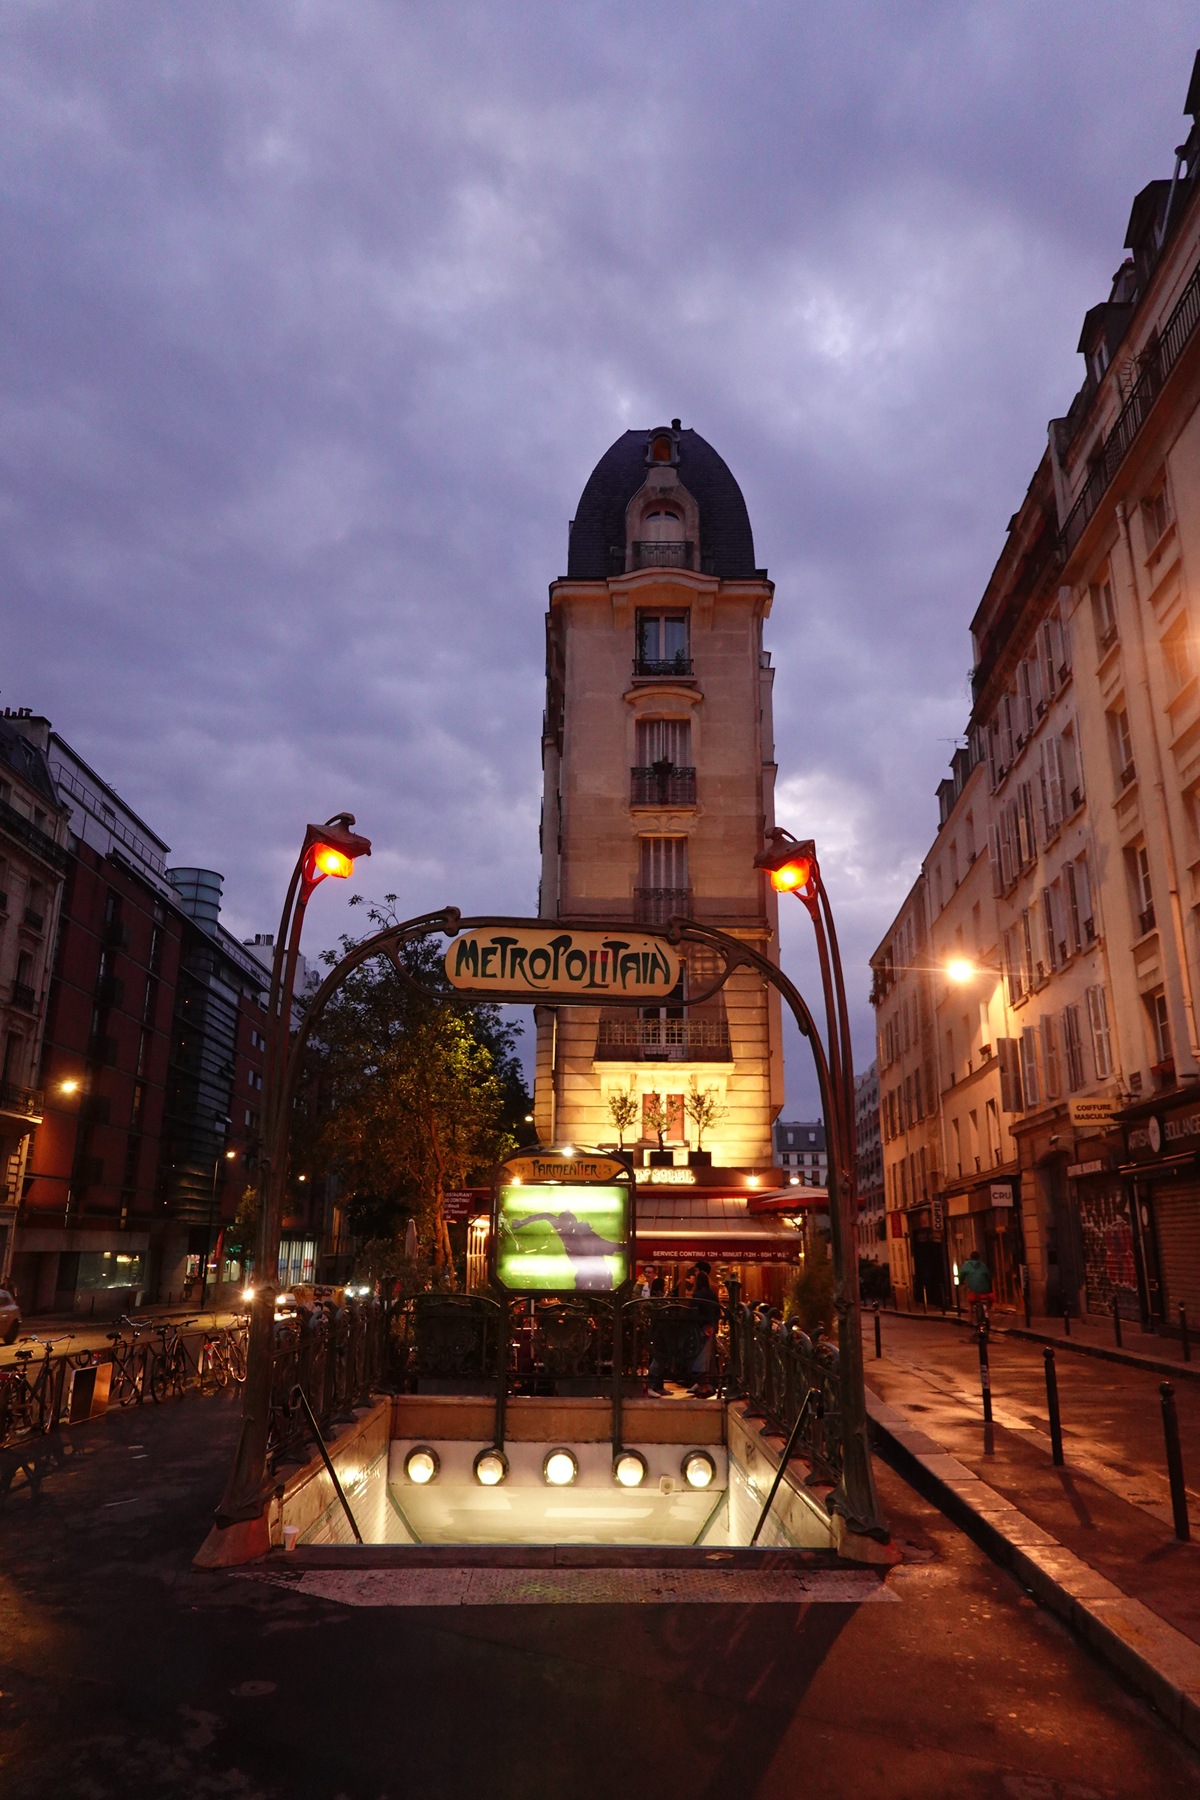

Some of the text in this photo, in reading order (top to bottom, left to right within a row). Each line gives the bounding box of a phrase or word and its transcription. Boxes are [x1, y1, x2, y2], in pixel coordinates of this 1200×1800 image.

[1076, 1104, 1112, 1112] COIFFURE
[531, 1159, 601, 1179] PARMENTIER
[651, 1169, 696, 1184] SOLEIL
[992, 1191, 1012, 1200] CRU
